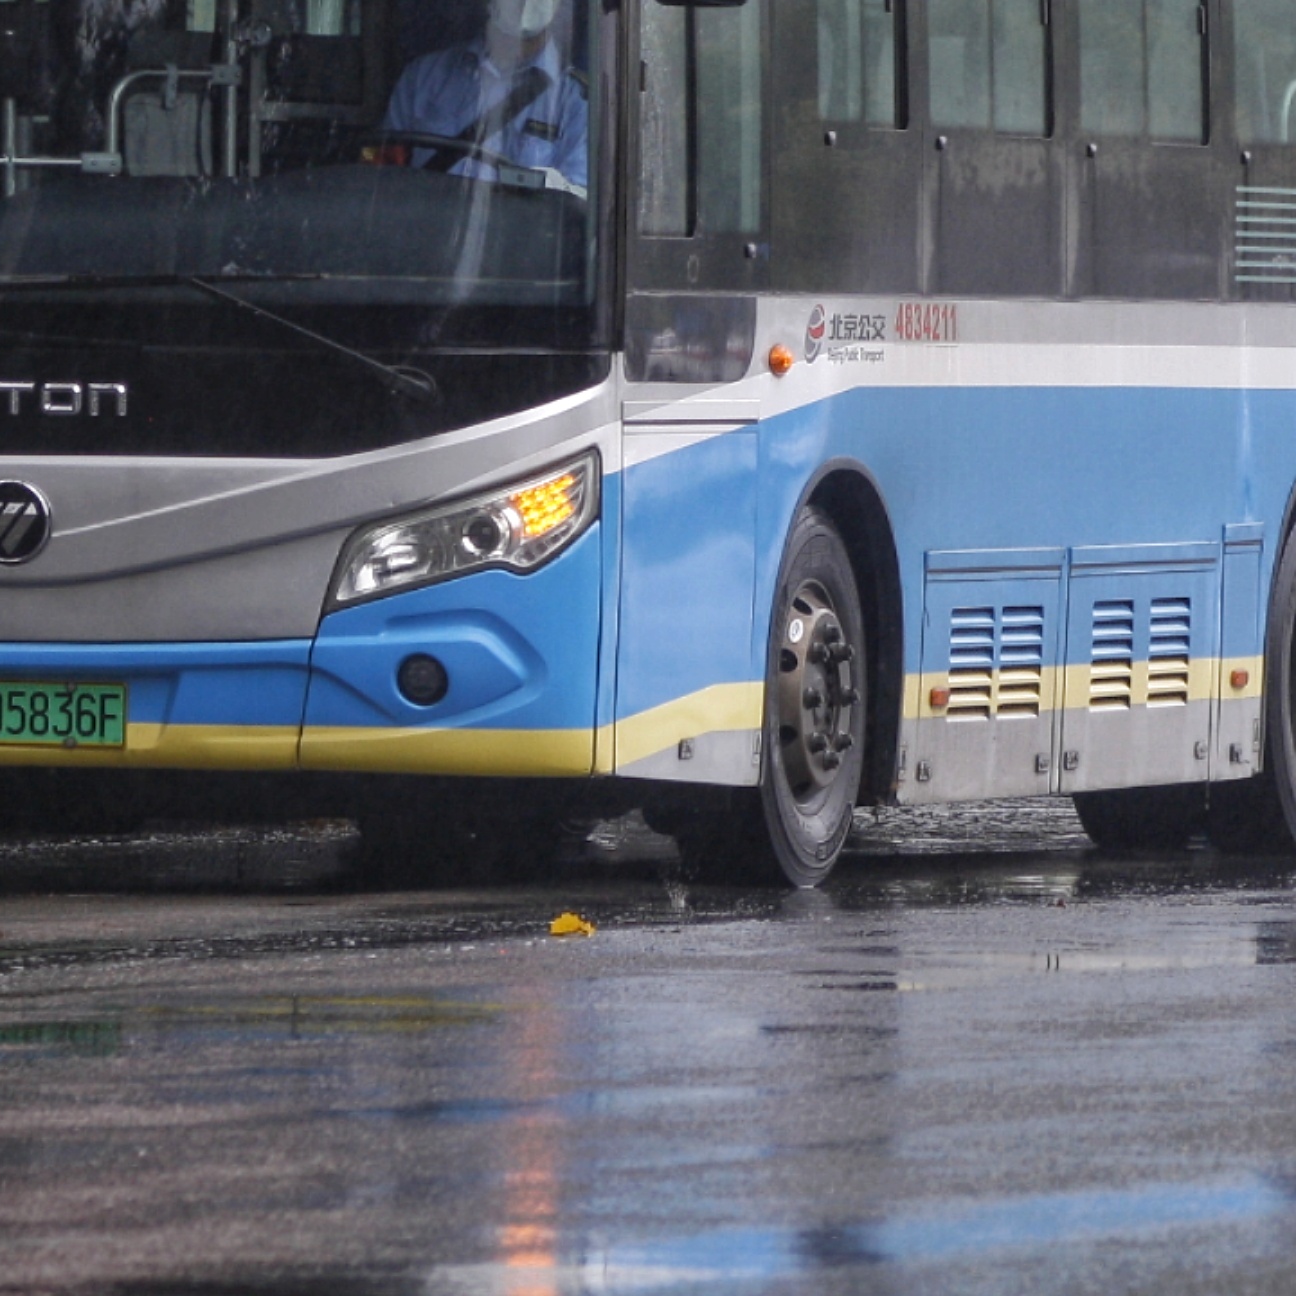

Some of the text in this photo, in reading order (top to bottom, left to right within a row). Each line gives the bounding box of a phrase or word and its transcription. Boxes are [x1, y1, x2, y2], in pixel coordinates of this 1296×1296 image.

[828, 303, 957, 341] 北京公交 4834211
